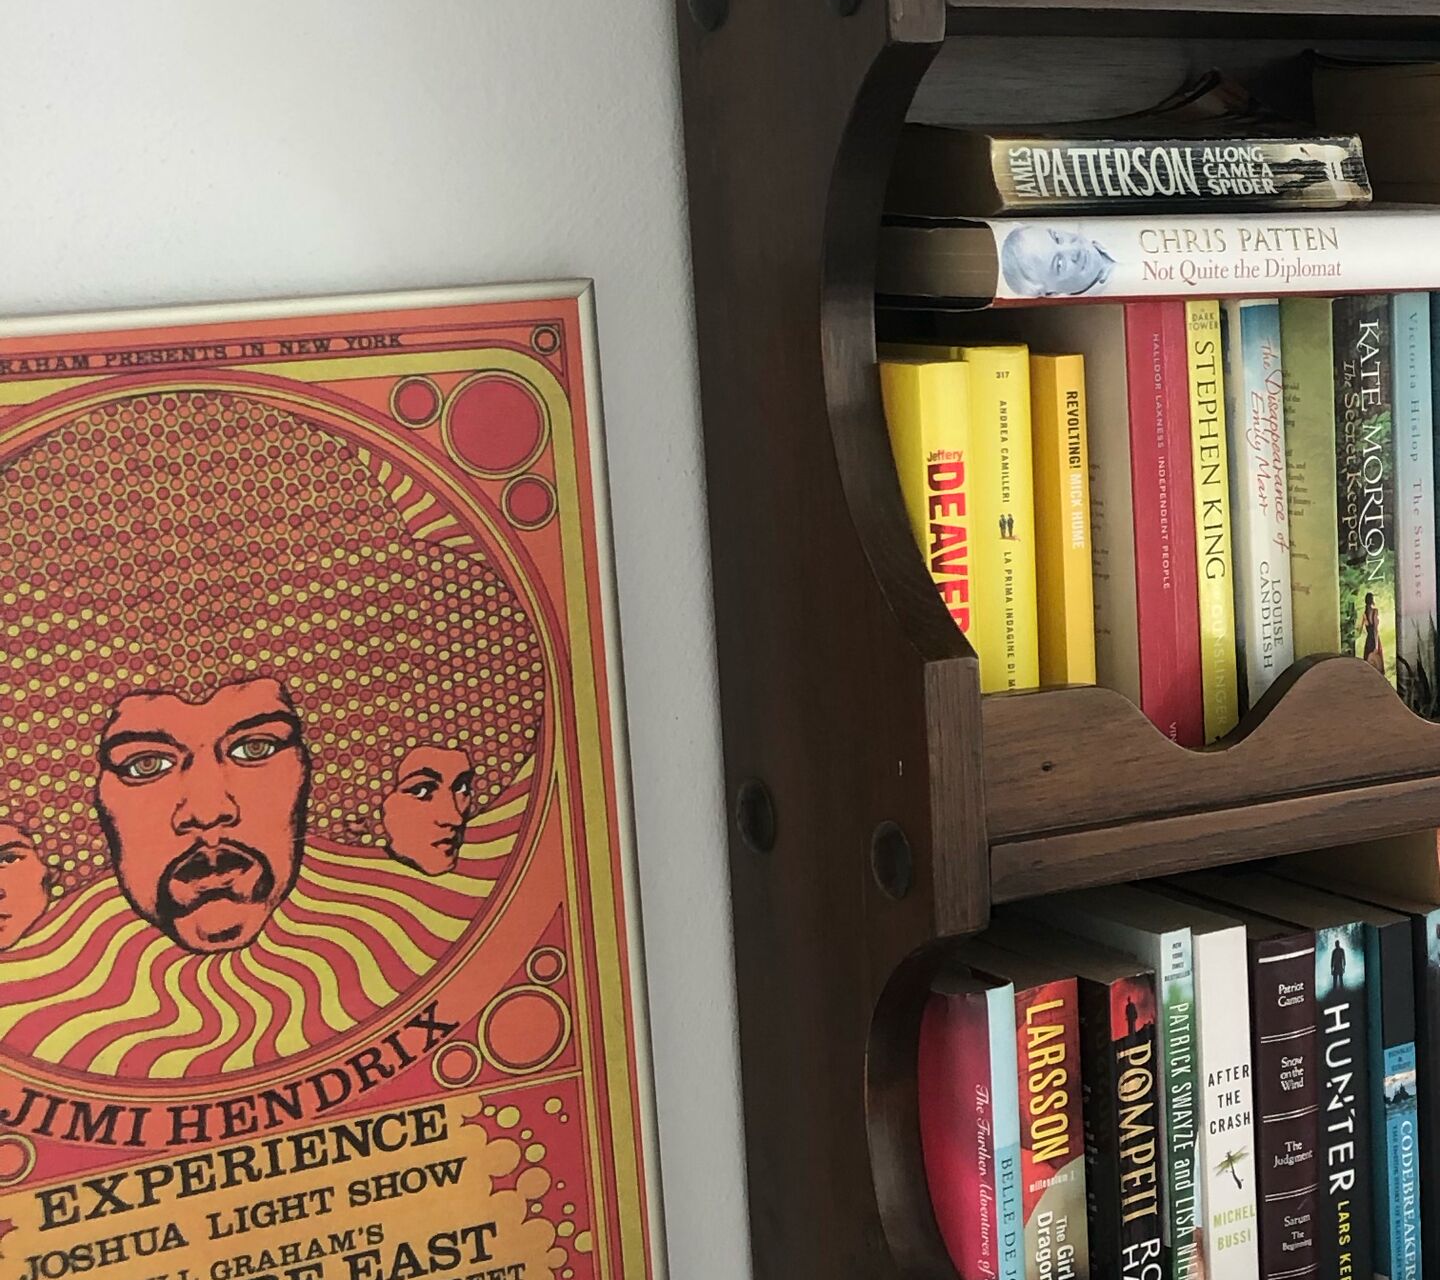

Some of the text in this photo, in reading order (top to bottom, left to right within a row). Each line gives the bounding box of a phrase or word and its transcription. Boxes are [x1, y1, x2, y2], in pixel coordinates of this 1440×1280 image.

[1009, 146, 1033, 198] JAMES
[1031, 146, 1201, 198] PATTERSON
[1201, 145, 1265, 164] ALONG
[1203, 162, 1274, 180] CAME A
[1207, 176, 1279, 197] SPIDER
[1138, 226, 1341, 255] CHRIS PATTEN
[1142, 258, 1342, 285] Not Quite the Diplomat
[105, 345, 228, 368] PRESENTS
[240, 342, 265, 359] IN
[278, 338, 333, 356] NEW
[347, 333, 401, 352] YORK
[994, 370, 1010, 380] 317
[998, 400, 1011, 504] ANDREA CAMILLERI
[1065, 389, 1085, 550] REVOLTING! MICK HUME
[1194, 339, 1227, 581] STEPHEN KING
[1341, 359, 1364, 552] The Secret Keeper
[1358, 317, 1386, 583] KATE MORTON
[2, 1000, 460, 1148] JIMI HENDRIX
[1024, 998, 1070, 1166] LARSSON
[1207, 1062, 1250, 1088] AFTER
[1217, 1090, 1241, 1107] THE
[1322, 1001, 1356, 1198] HUNTER
[1115, 1039, 1161, 1226] POMPEII
[1209, 1111, 1251, 1135] CRASH
[34, 1103, 450, 1232] EXPERIENCE
[1000, 1156, 1015, 1220] BELLE
[205, 1185, 337, 1241] LIGHT
[348, 1156, 468, 1209] SHOW
[1212, 1203, 1256, 1229] MICHEL
[1002, 1230, 1016, 1265] DE
[1216, 1228, 1253, 1252] BUSSI
